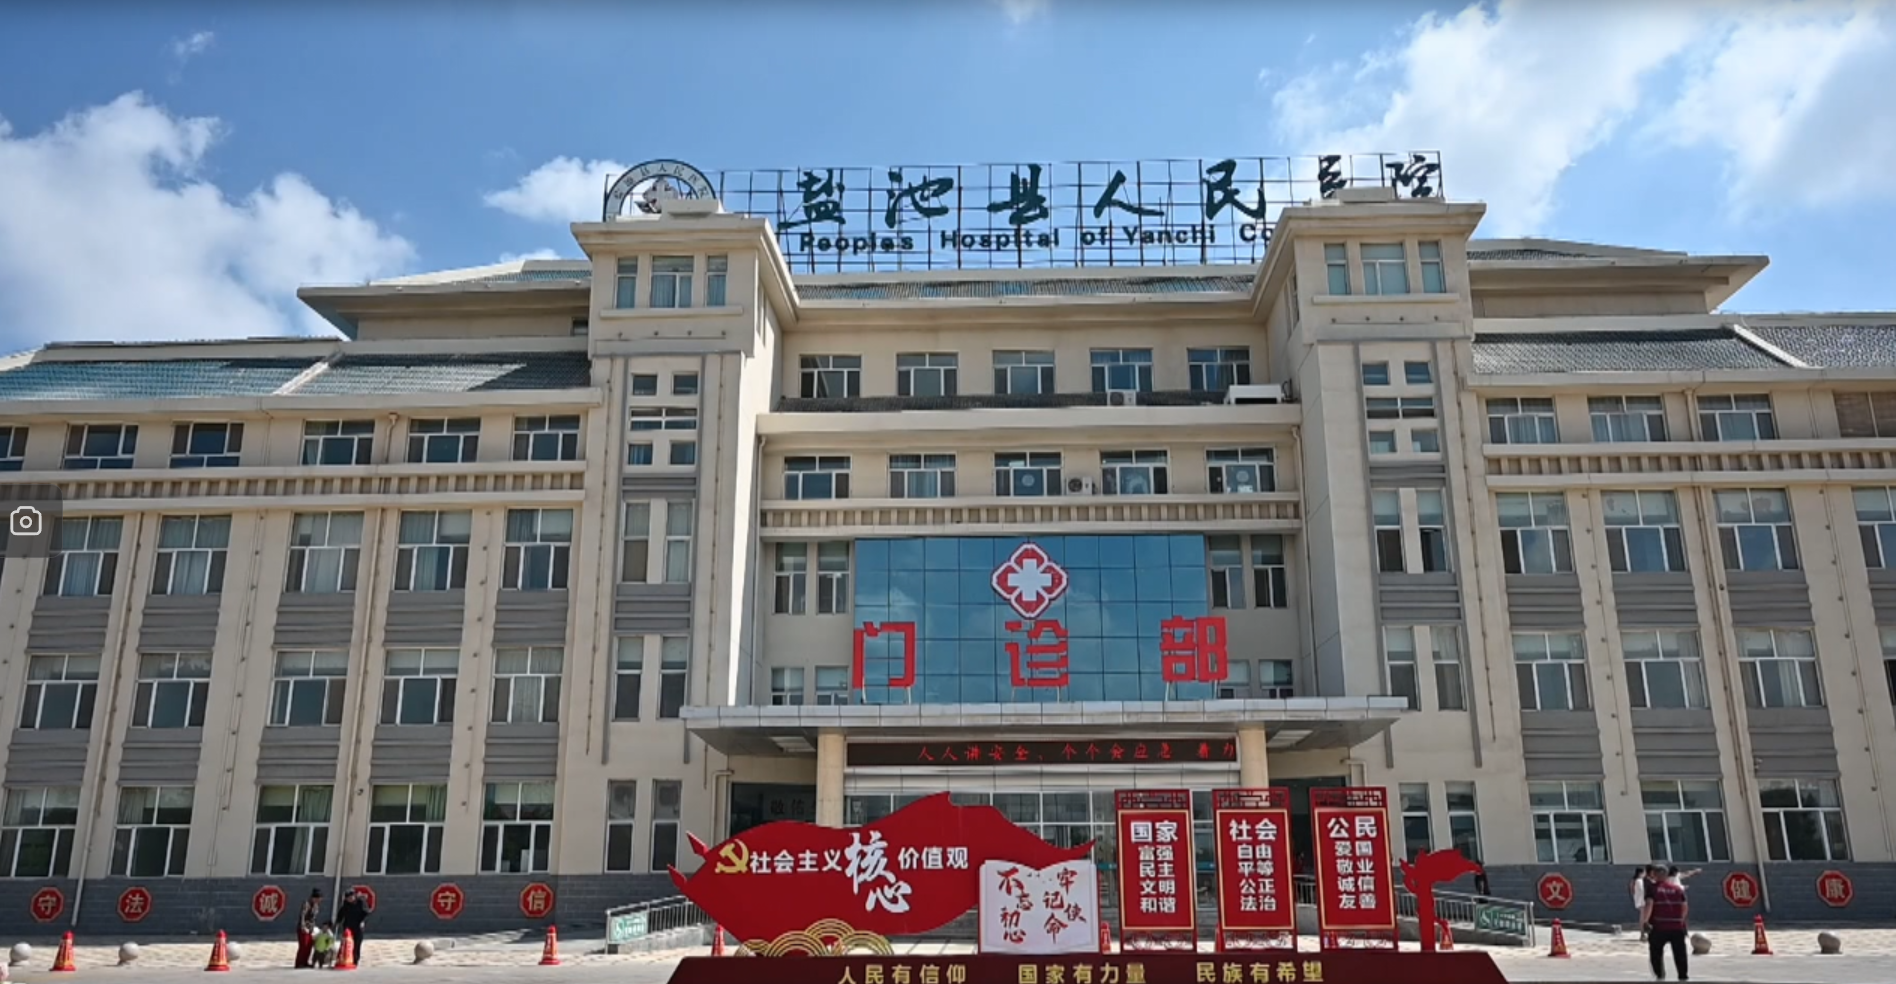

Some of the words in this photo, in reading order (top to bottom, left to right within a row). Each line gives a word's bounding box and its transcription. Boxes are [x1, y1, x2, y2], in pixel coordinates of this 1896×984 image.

[940, 228, 1060, 251] Hospital
[1080, 226, 1107, 245] of
[1122, 224, 1216, 245] Yanchi
[852, 616, 1229, 689] 门诊部
[1130, 820, 1178, 843] 国家
[1229, 818, 1277, 842] 社会
[1327, 816, 1377, 838] 公民
[1138, 845, 1174, 861] 富强
[1237, 843, 1272, 859] 自由
[1335, 840, 1373, 857] 爱国
[750, 848, 842, 874] 社会主义
[844, 830, 912, 914] 核心
[898, 846, 969, 870] 价值观
[1139, 862, 1175, 878] 民主
[1238, 860, 1274, 876] 平等
[1336, 858, 1375, 875] 敬业
[1140, 879, 1176, 895] 文明
[1239, 878, 1275, 894] 公正
[1337, 876, 1375, 892] 诚信
[997, 866, 1034, 945] 不忘初心
[1042, 866, 1087, 945] 牢记使命
[1140, 896, 1176, 913] 和谐
[1240, 895, 1276, 911] 法治
[1338, 893, 1376, 909] 友善
[838, 963, 967, 984] 人民有信仰
[1018, 963, 1147, 984] 国家有力量
[1196, 961, 1324, 983] 民族有希望
